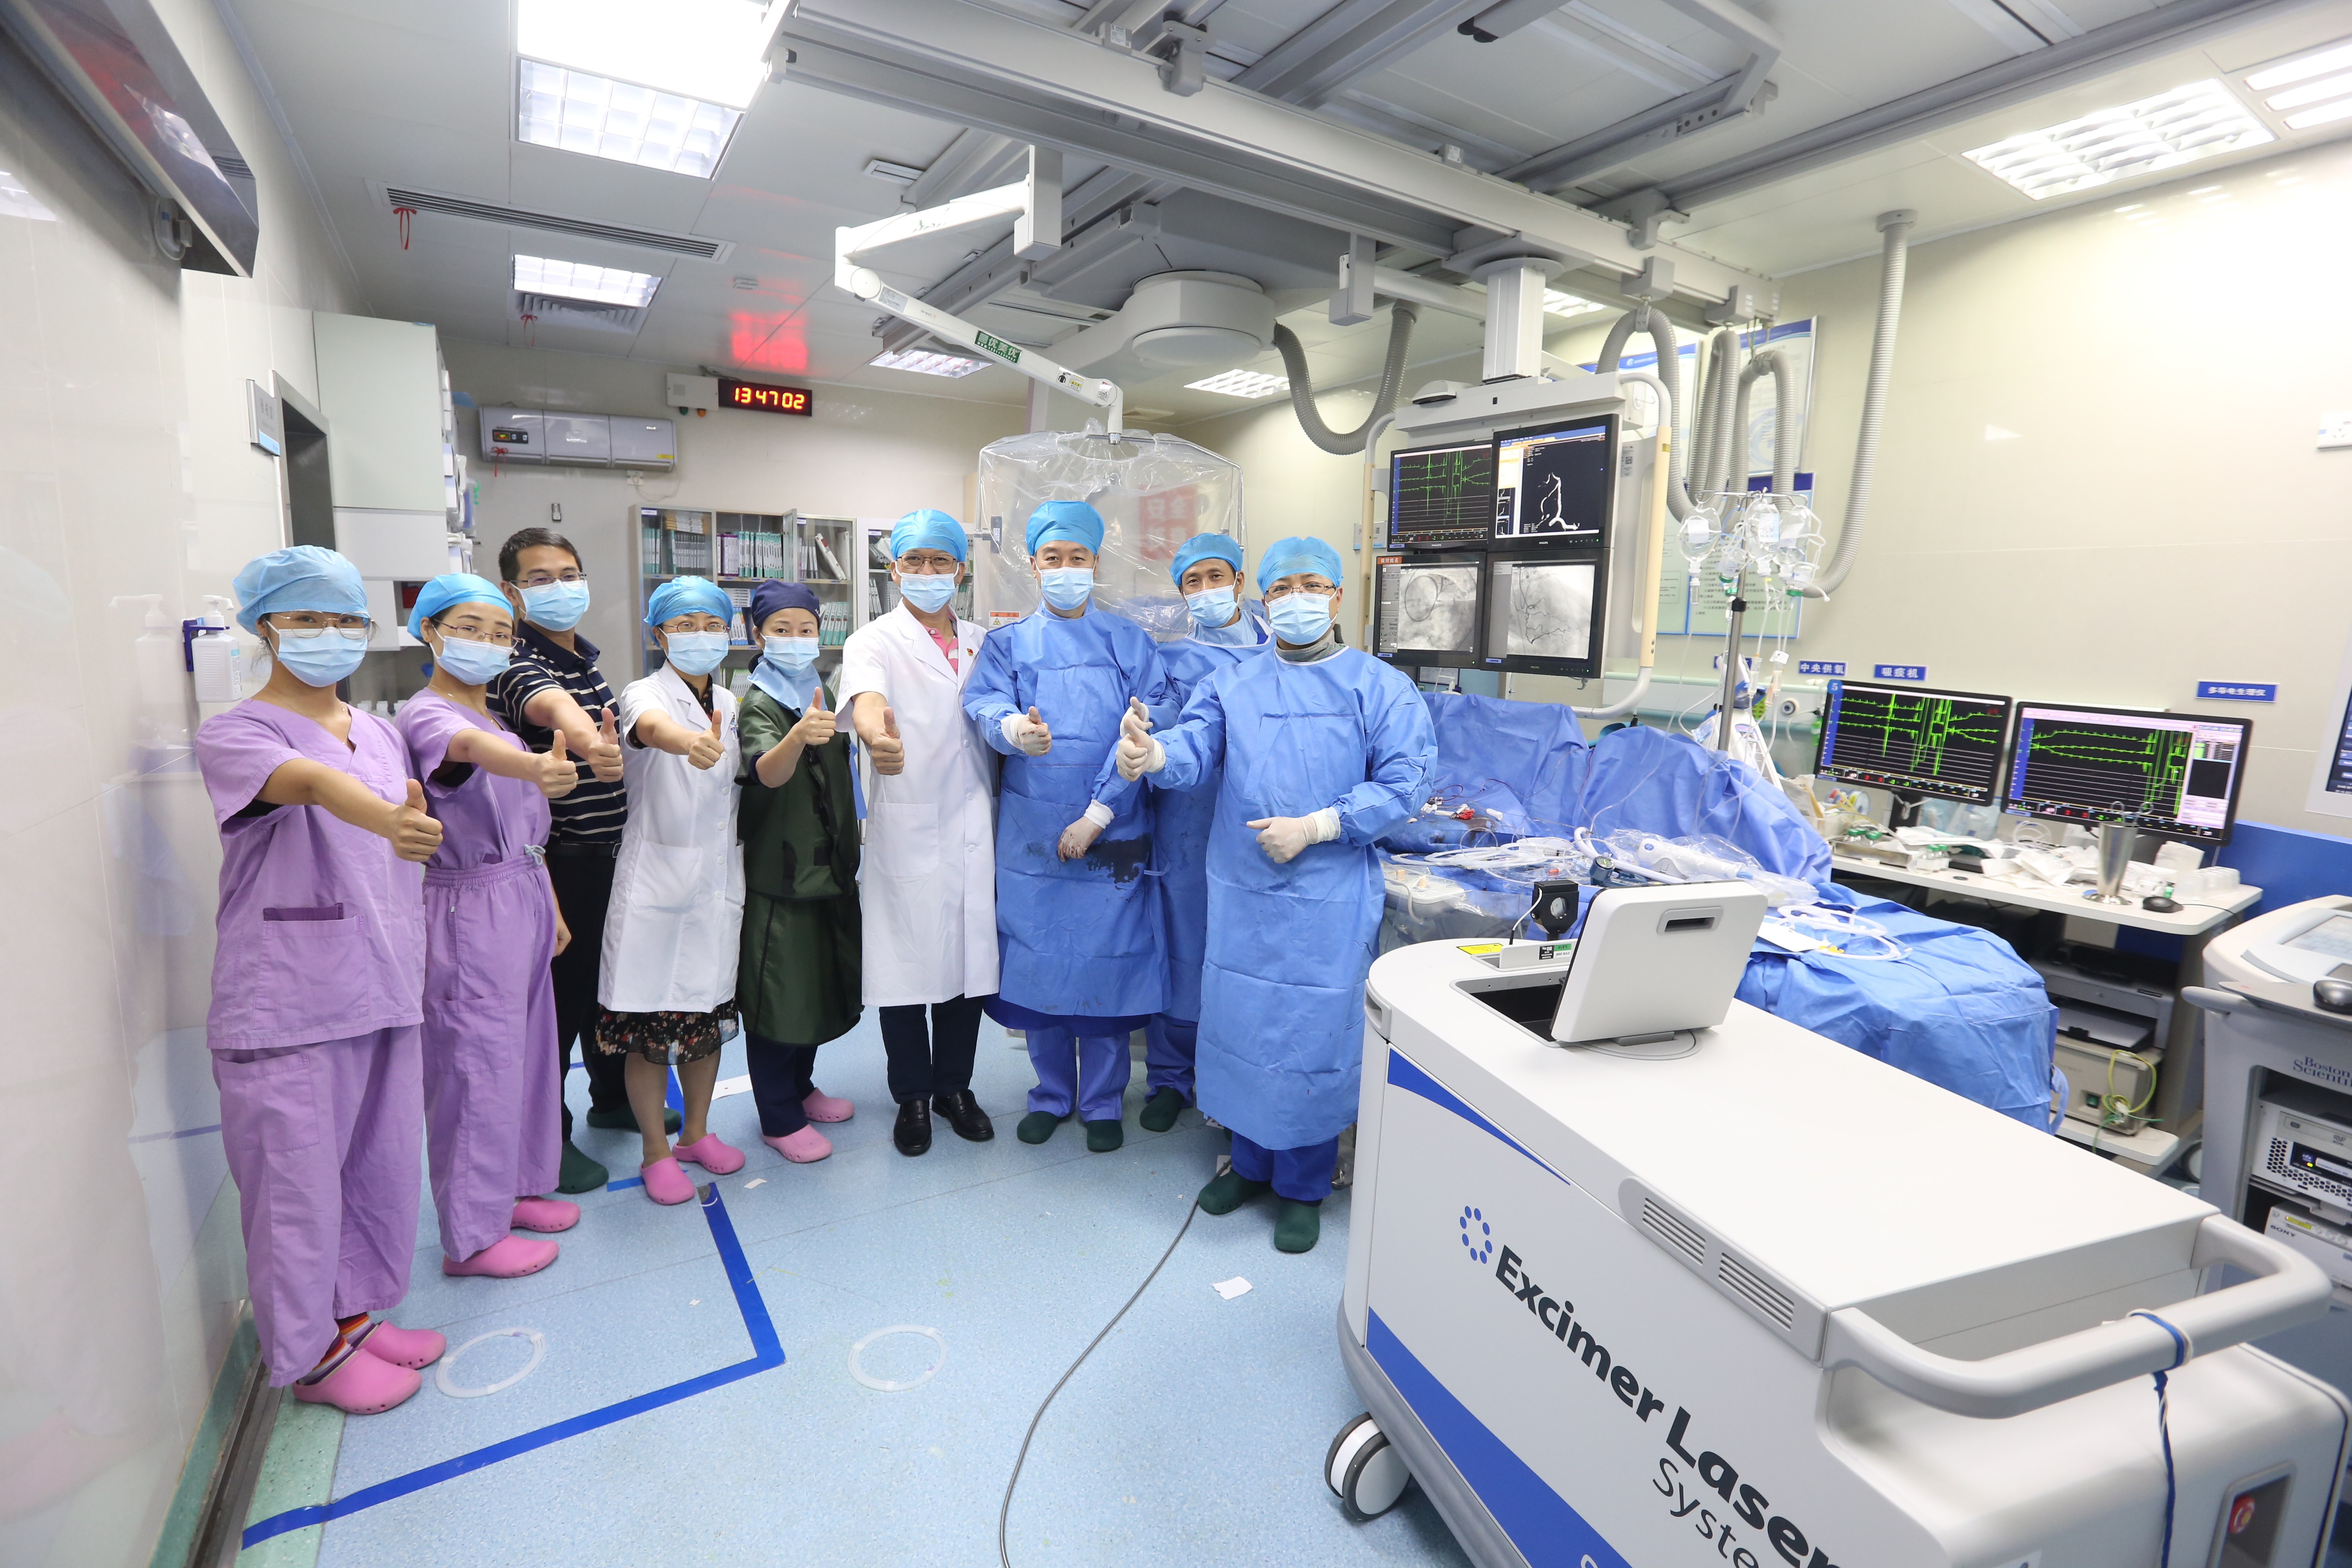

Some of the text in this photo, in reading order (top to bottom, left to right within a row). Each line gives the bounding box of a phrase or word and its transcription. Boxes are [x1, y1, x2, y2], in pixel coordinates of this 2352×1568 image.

[988, 337, 1018, 359] 优美优
[1801, 663, 1844, 674] 中央供氧
[1882, 668, 1918, 678] 吸痰机
[2293, 1060, 2352, 1087] Scienti
[2305, 1056, 2350, 1078] Boston
[2270, 1225, 2296, 1237] SONY
[1495, 1244, 1665, 1423] Excimer
